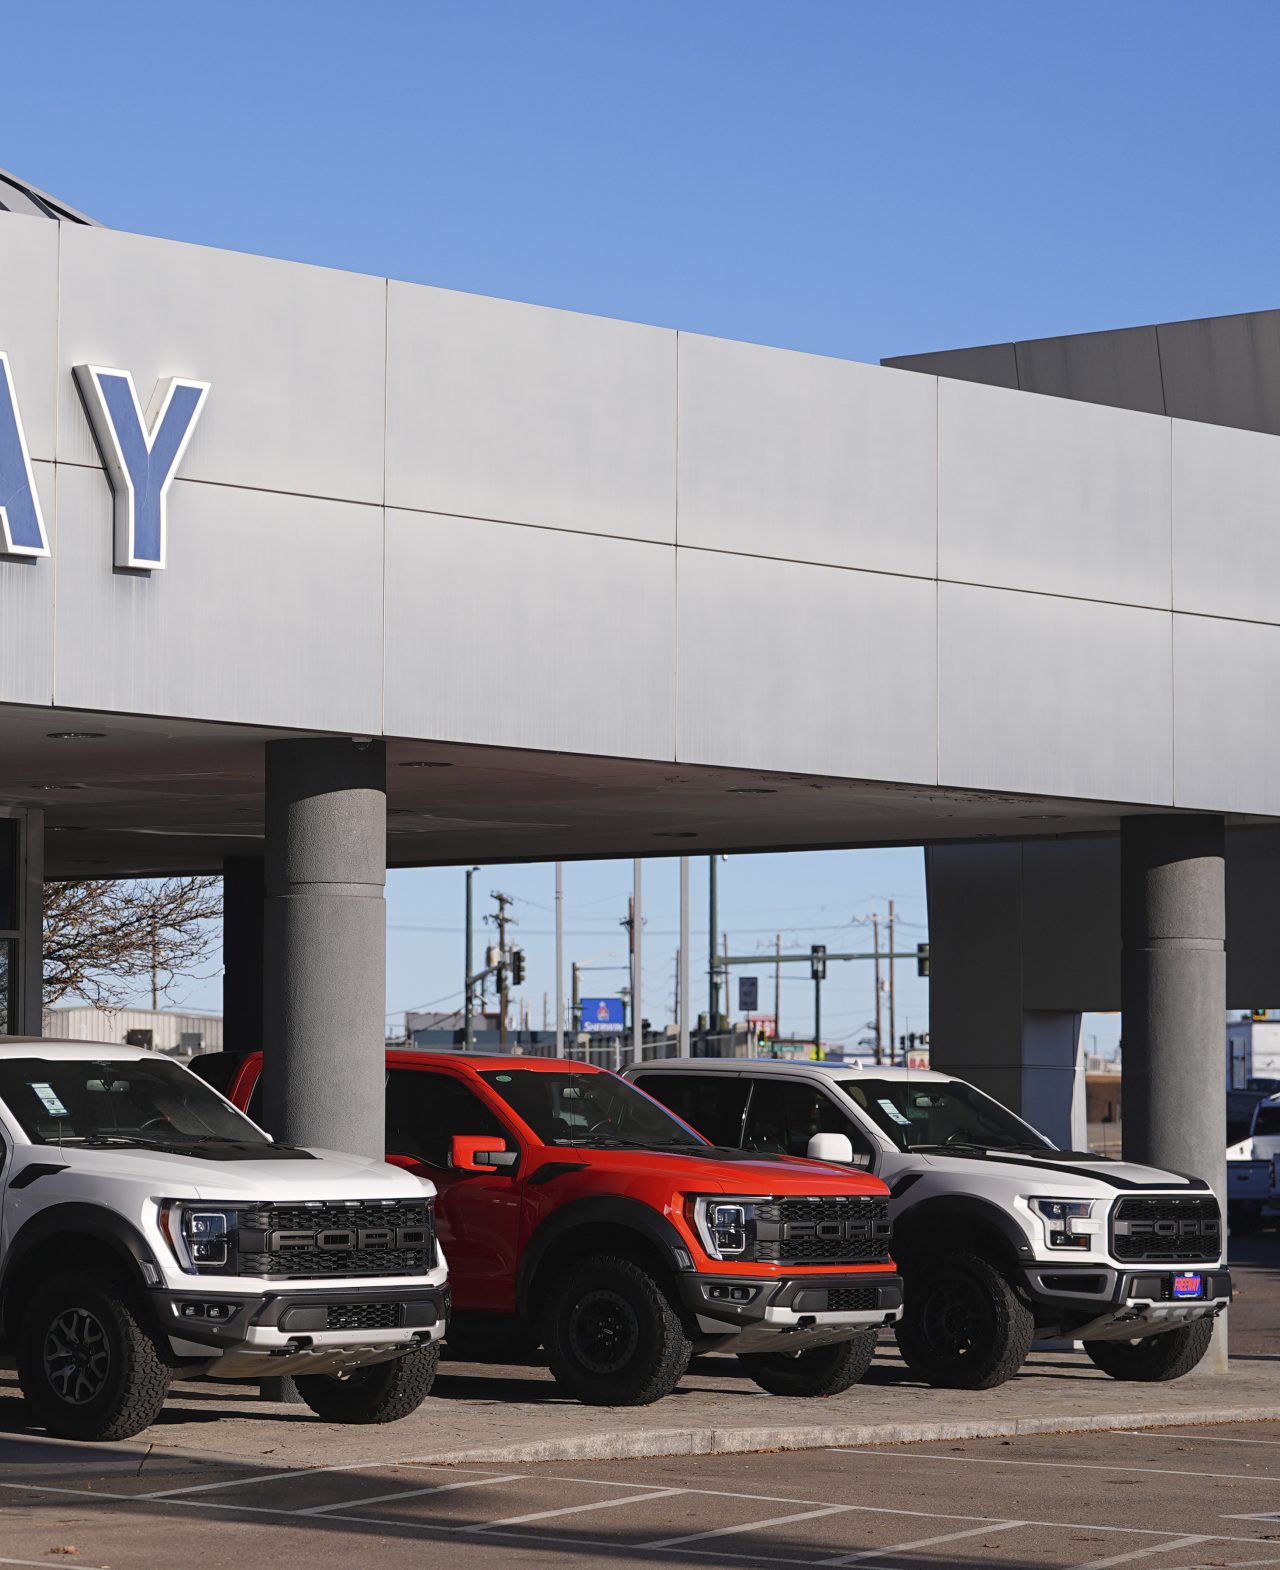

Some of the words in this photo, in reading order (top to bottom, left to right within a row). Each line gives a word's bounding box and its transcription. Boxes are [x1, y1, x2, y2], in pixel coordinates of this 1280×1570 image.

[784, 1220, 893, 1239] FORD
[1127, 1219, 1219, 1236] FORD
[271, 1228, 430, 1251] FORD
[1173, 1277, 1201, 1291] FREEWAY
